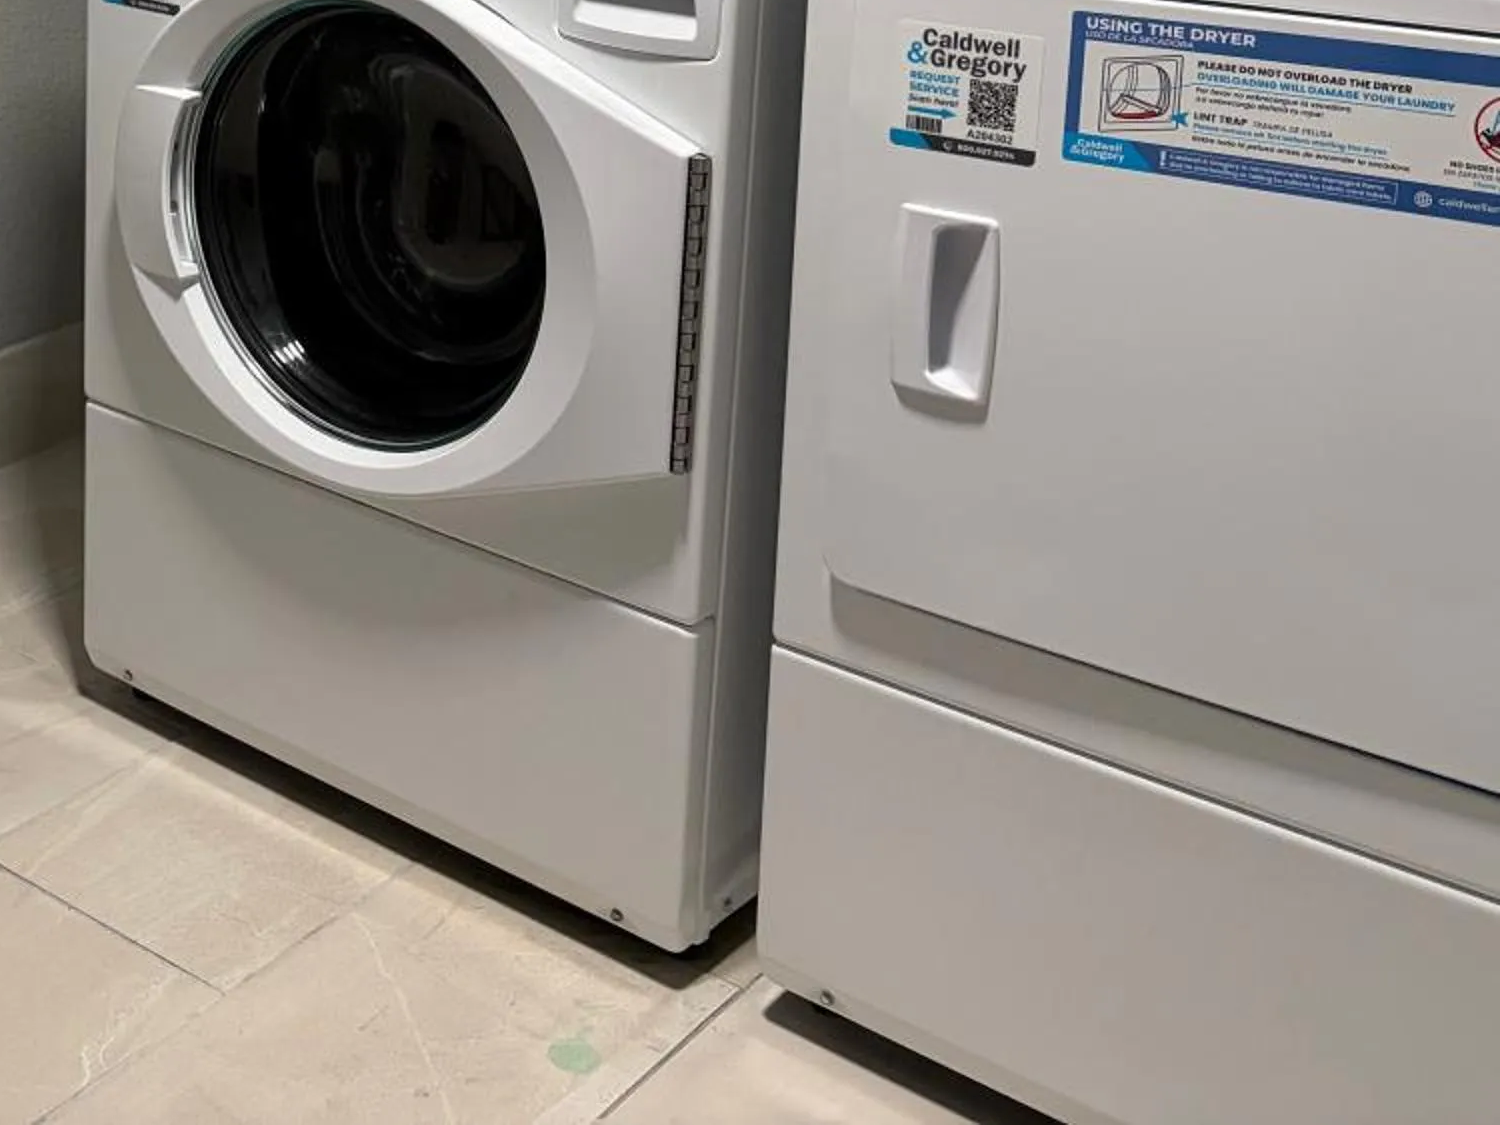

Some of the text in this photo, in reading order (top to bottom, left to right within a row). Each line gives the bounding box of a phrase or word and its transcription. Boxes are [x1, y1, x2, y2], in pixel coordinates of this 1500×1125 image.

[923, 28, 1020, 59] Caldwell
[1086, 17, 1256, 48] USING THE DRYER
[910, 70, 960, 85] REQUEST
[910, 81, 959, 96] SERVICE
[1197, 60, 1413, 94] PLEASE DO NOT OVERLOAD THE DRYER
[1197, 72, 1455, 112] OVERLOADING WILL DAMAGE YOUR LAUNDRY
